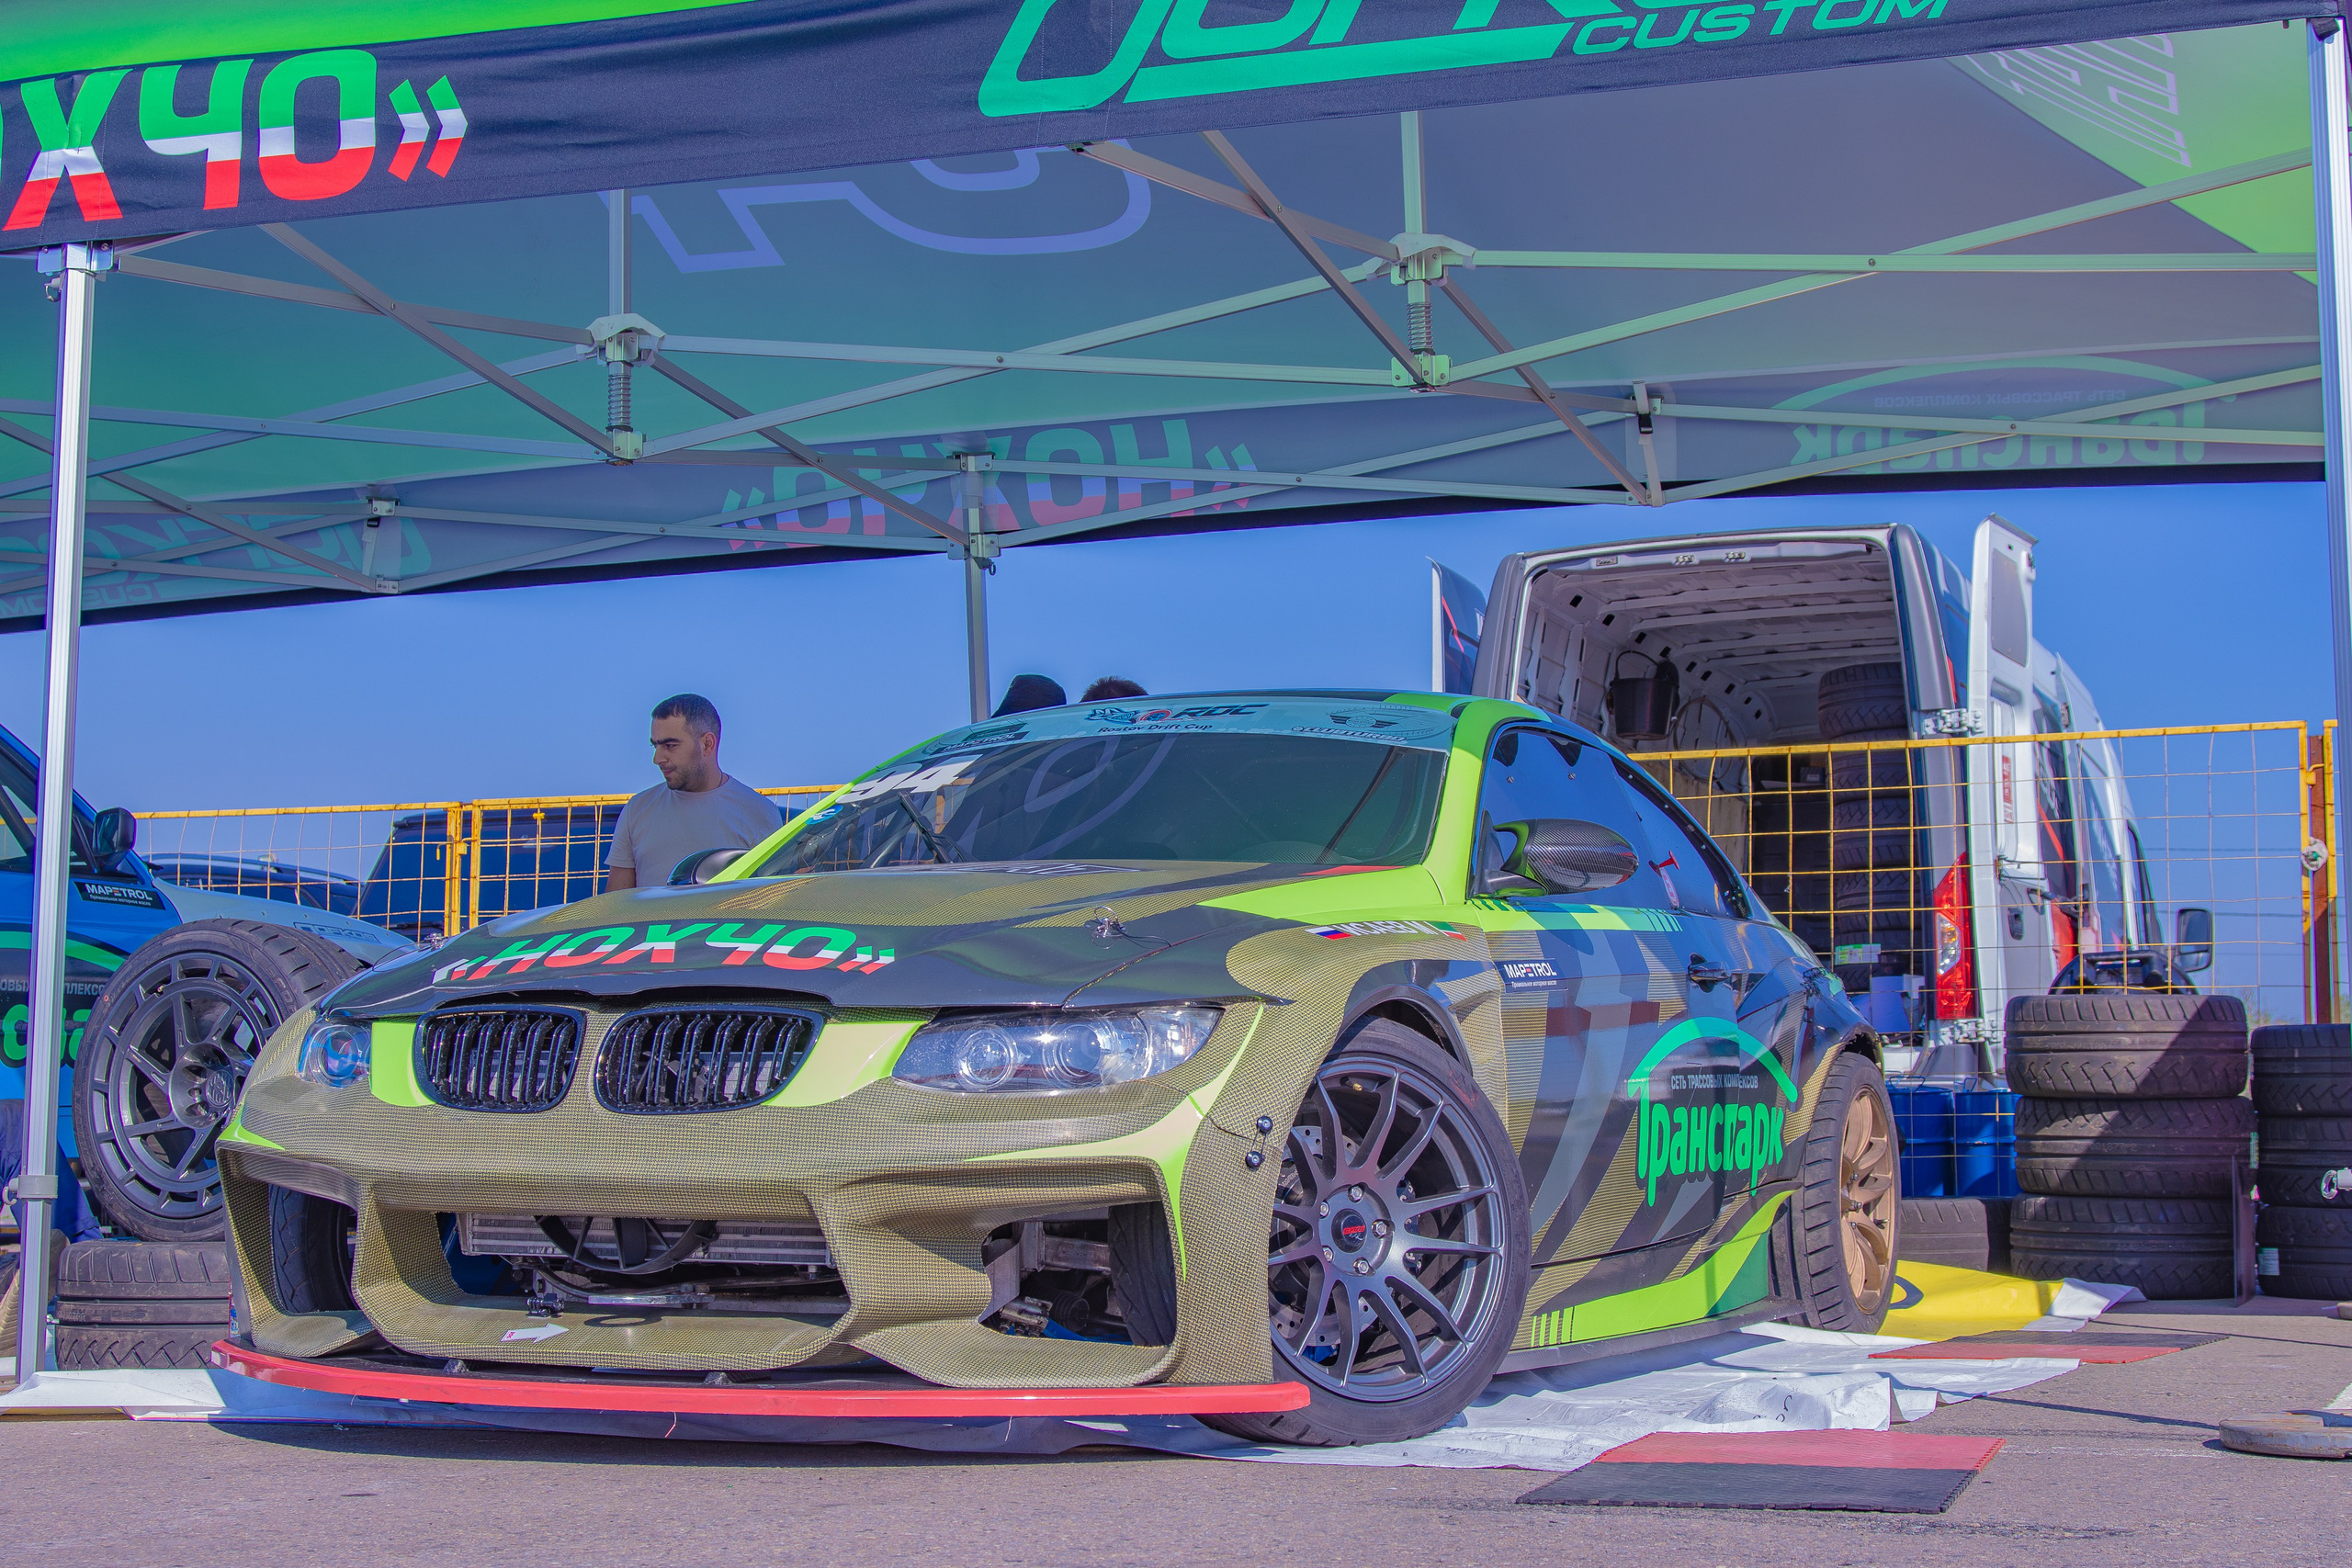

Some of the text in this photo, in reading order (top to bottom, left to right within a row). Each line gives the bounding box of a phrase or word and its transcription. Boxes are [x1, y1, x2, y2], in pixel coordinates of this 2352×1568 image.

[1572, 0, 1949, 55] CUSTOM
[0, 48, 469, 231] ХЧО»
[1097, 723, 1214, 734] Rostov Drift Cup
[835, 754, 984, 804] 94
[85, 883, 153, 901] MAPETROL
[1503, 962, 1557, 978] MAPETROL
[1670, 1075, 1687, 1090] СЕТЬ
